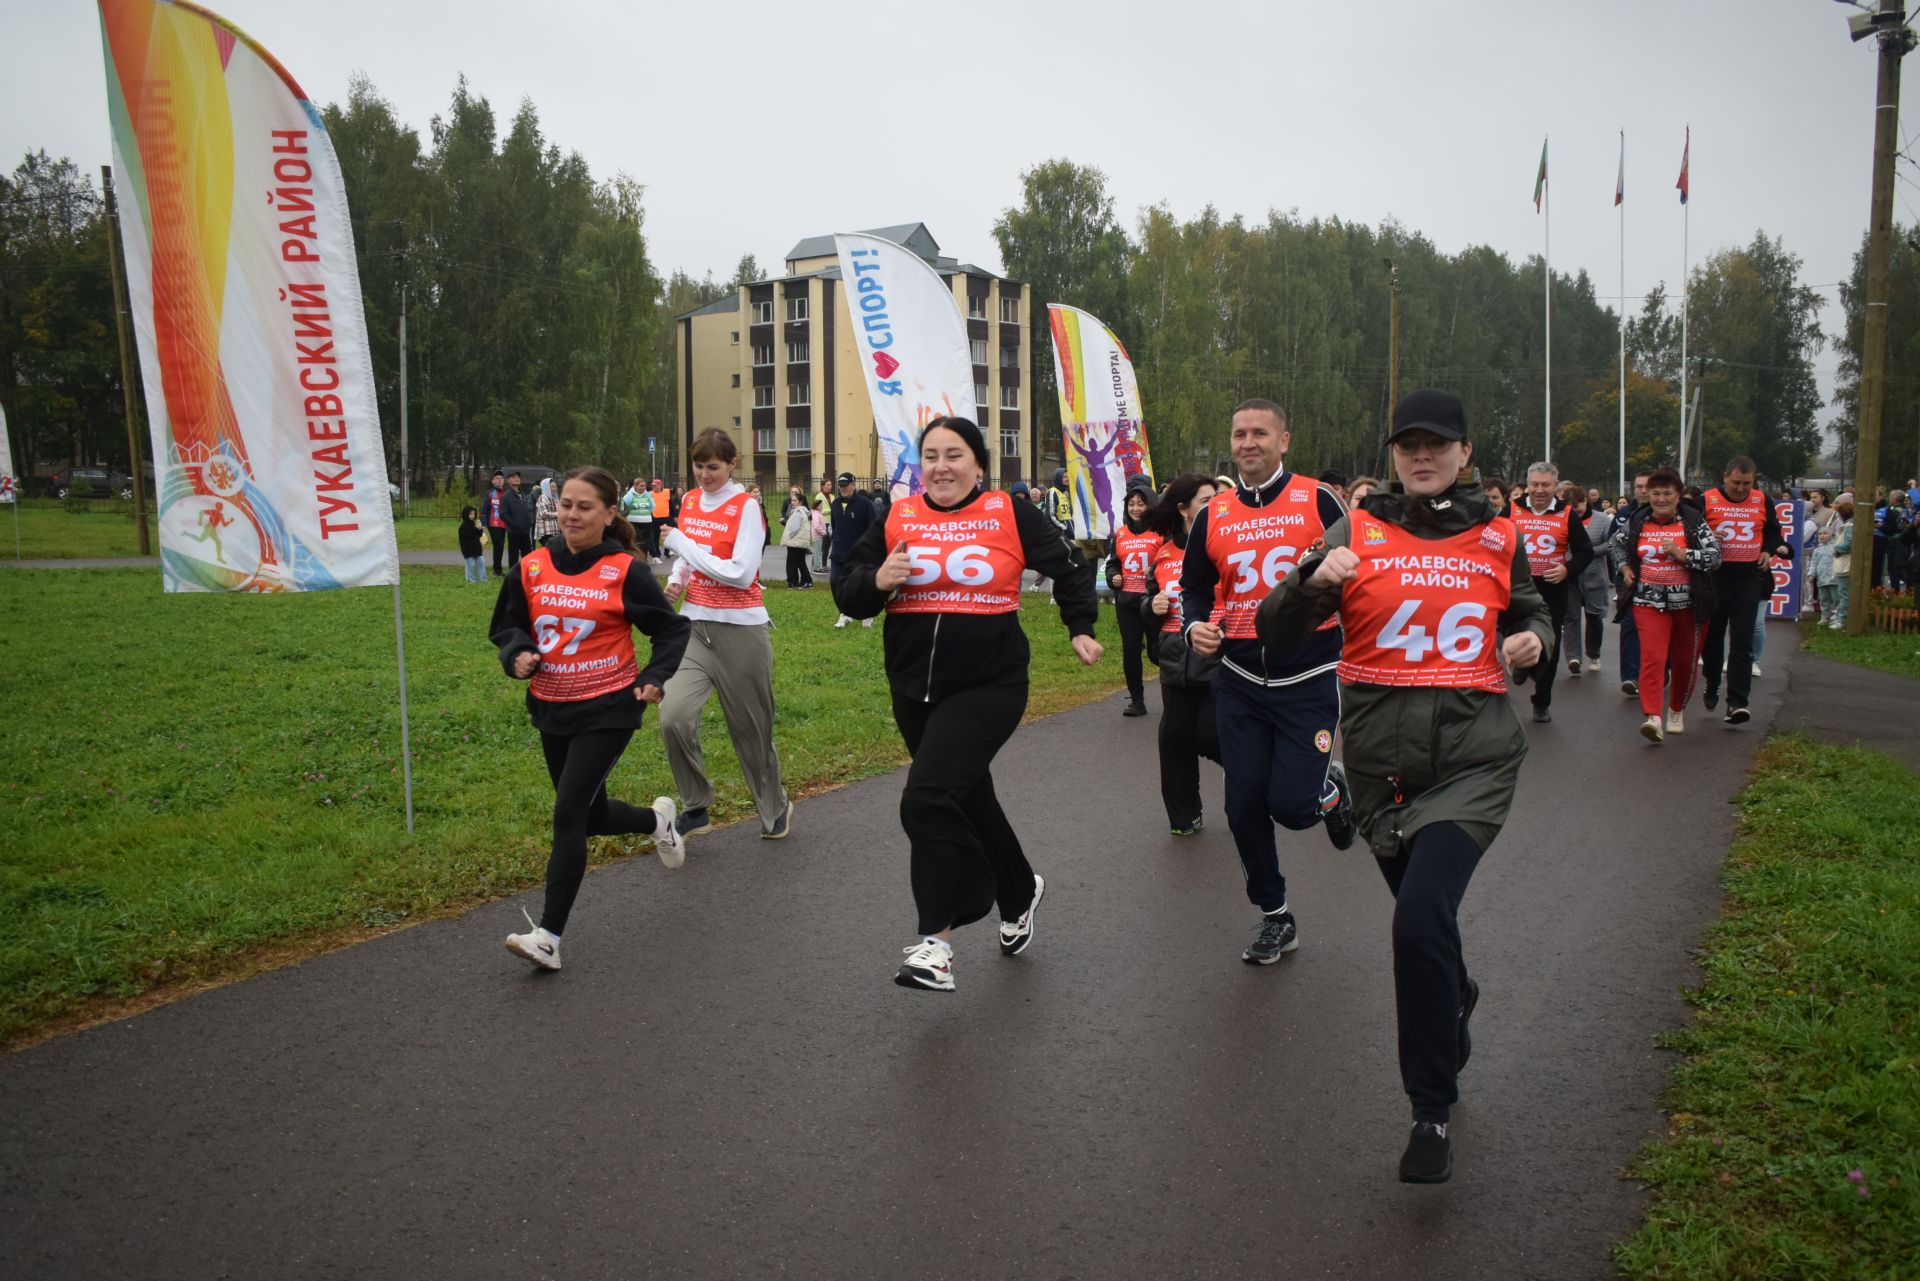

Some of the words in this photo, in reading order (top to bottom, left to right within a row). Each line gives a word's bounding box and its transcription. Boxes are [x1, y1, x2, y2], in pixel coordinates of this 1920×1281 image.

[266, 130, 320, 262] РАЙОН
[850, 249, 894, 349] СПОРТ!
[1110, 350, 1124, 397] СПОРТА!
[878, 380, 903, 396] Я
[279, 283, 359, 540] ТУКАЕВСКИЙ
[685, 526, 712, 538] РАЙОН
[902, 518, 1000, 532] ТУКАЕВСКИЙ
[1219, 513, 1305, 536] ТУКАЕВСКИЙ
[1237, 527, 1284, 543] РАЙОН
[1516, 520, 1560, 528] ТУКАЕВСКИЙ
[1716, 520, 1755, 541] 63
[921, 532, 977, 542] РАЙОН
[1523, 533, 1556, 555] 49
[905, 544, 995, 586] 56
[1124, 551, 1149, 573] 41
[1227, 545, 1297, 593] 36
[1371, 555, 1496, 577] ТУКАЕВСКИЙ
[1401, 571, 1469, 589] РАЙОН
[541, 596, 586, 609] РАЙОН
[918, 591, 970, 602] НОРМА
[534, 614, 597, 656] 67
[1376, 599, 1487, 662] 46
[577, 655, 619, 672] ЖИЗНИ
